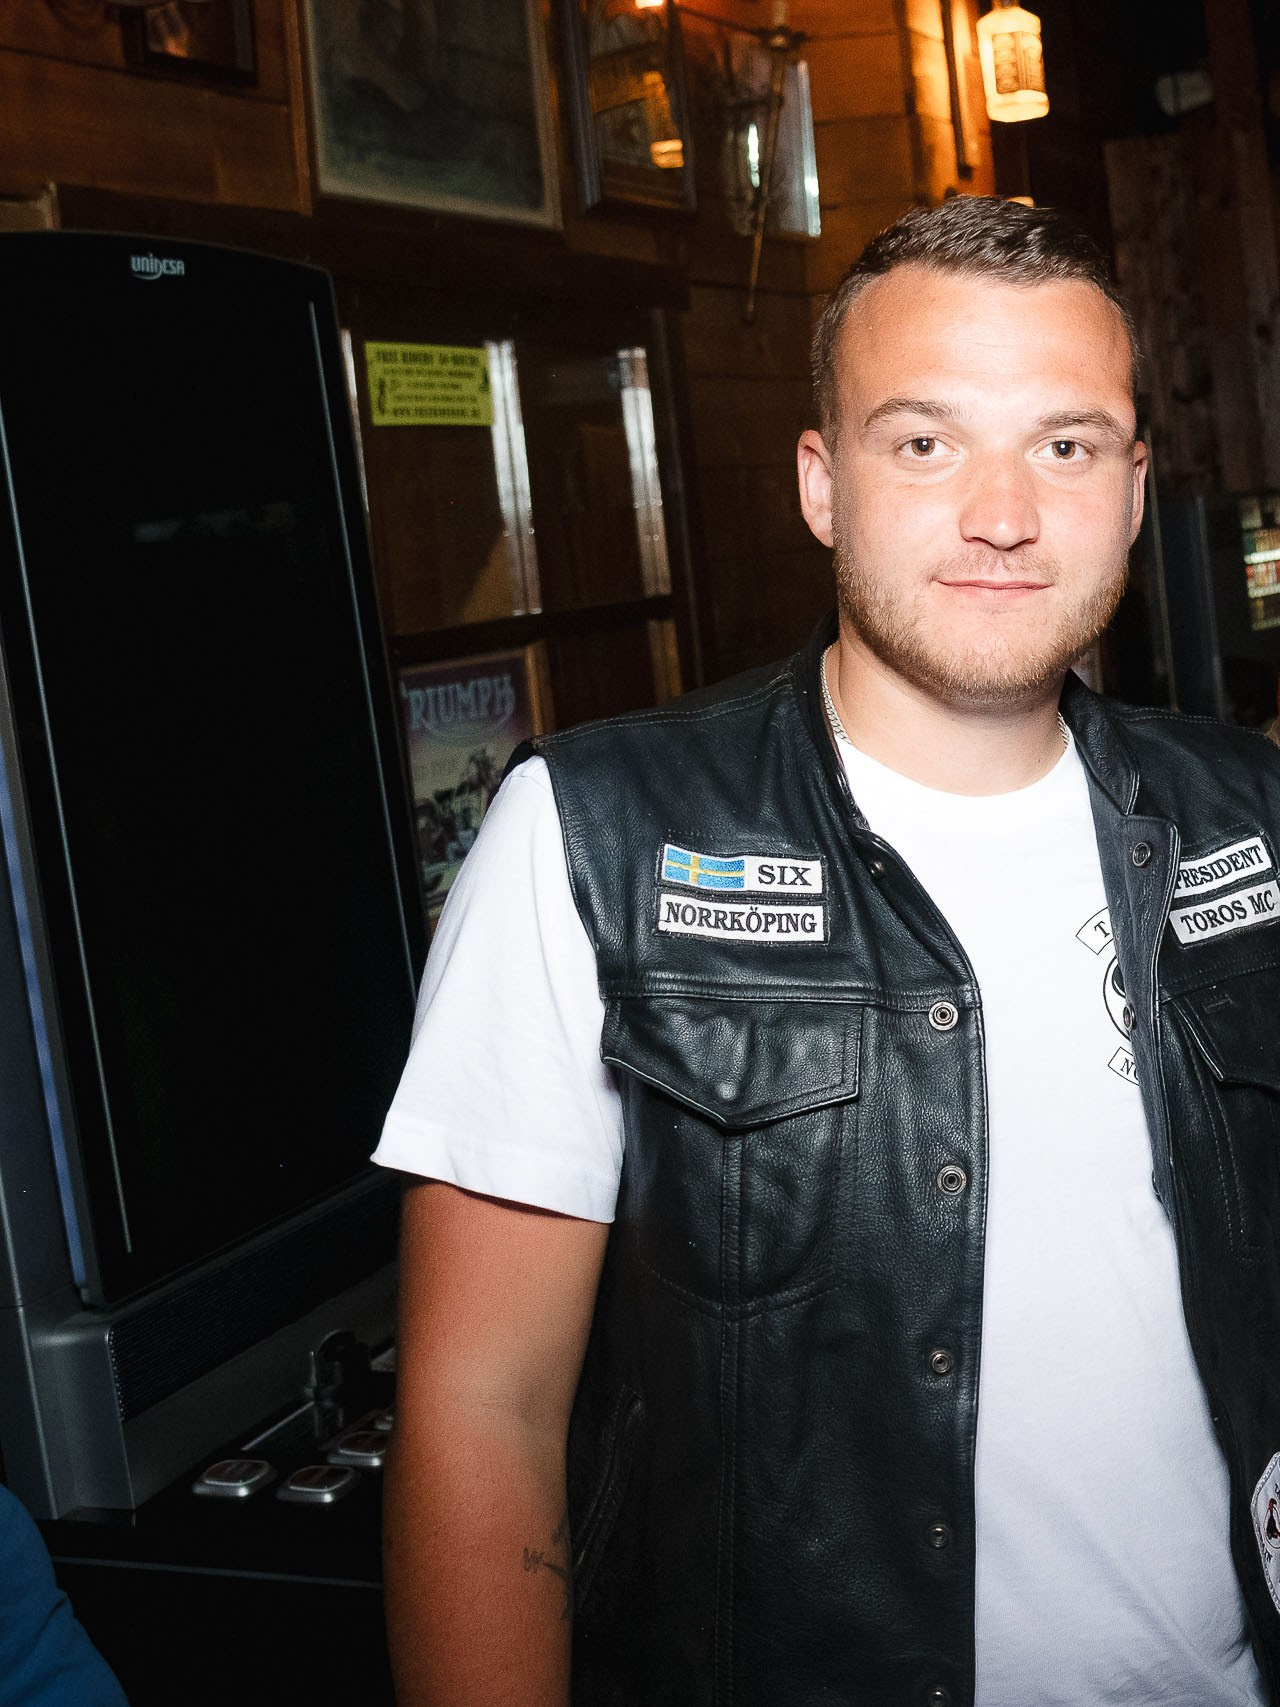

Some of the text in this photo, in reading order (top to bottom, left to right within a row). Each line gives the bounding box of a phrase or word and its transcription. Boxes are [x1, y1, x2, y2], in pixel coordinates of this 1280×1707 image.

[402, 675, 515, 731] RIUMPH
[757, 864, 812, 887] SIX
[664, 901, 818, 934] NORRKÖPING
[1180, 889, 1276, 935] TOROS MC
